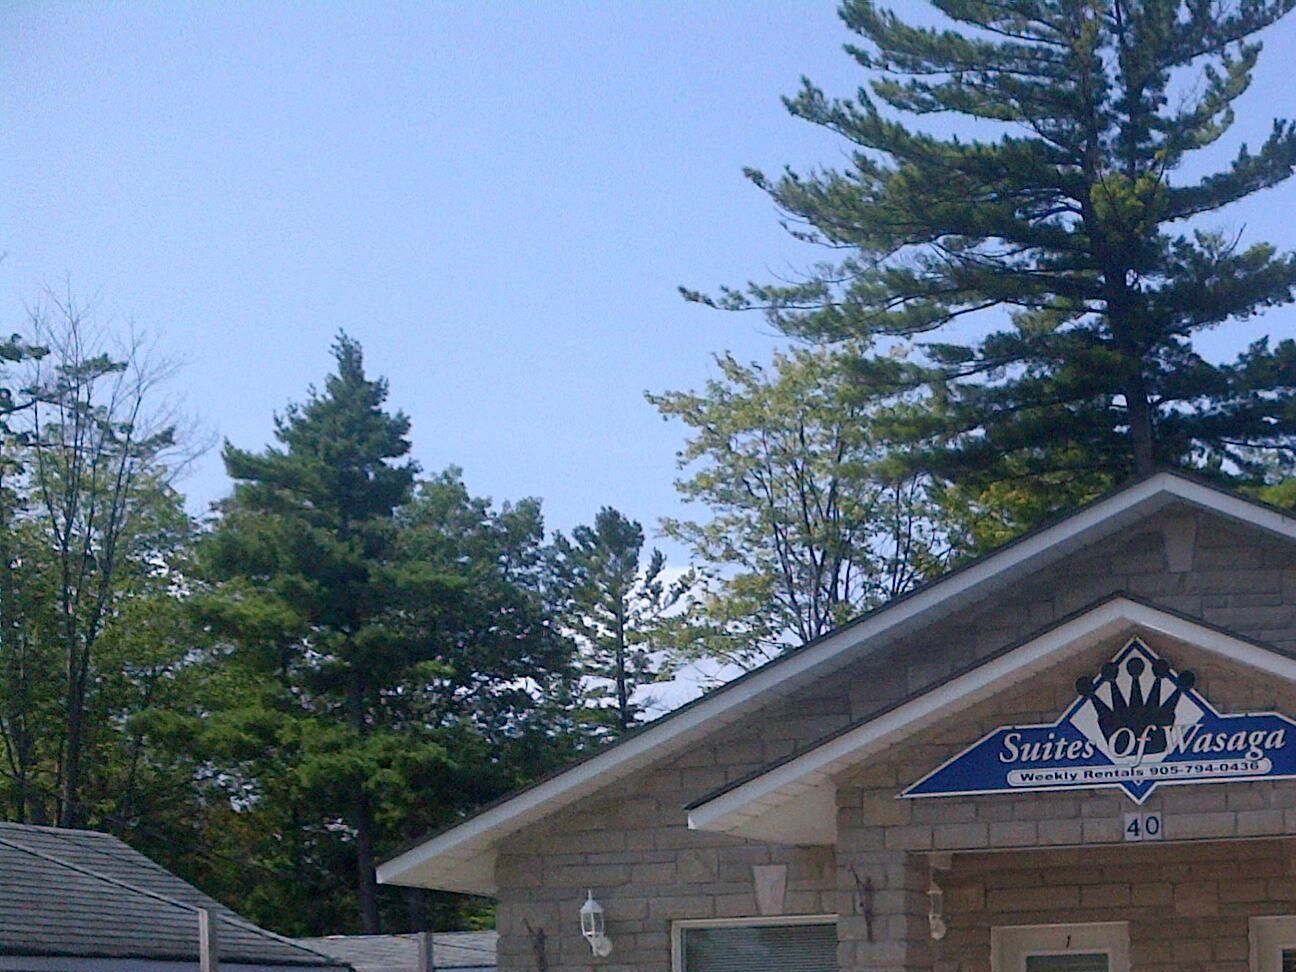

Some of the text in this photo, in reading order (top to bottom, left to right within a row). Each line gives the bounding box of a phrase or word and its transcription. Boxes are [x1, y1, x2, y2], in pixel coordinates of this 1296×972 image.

[999, 723, 1286, 768] Suites Of Wasaga
[1020, 772, 1078, 782] Weekly
[1083, 768, 1144, 779] Rentals
[1126, 816, 1159, 836] 40
